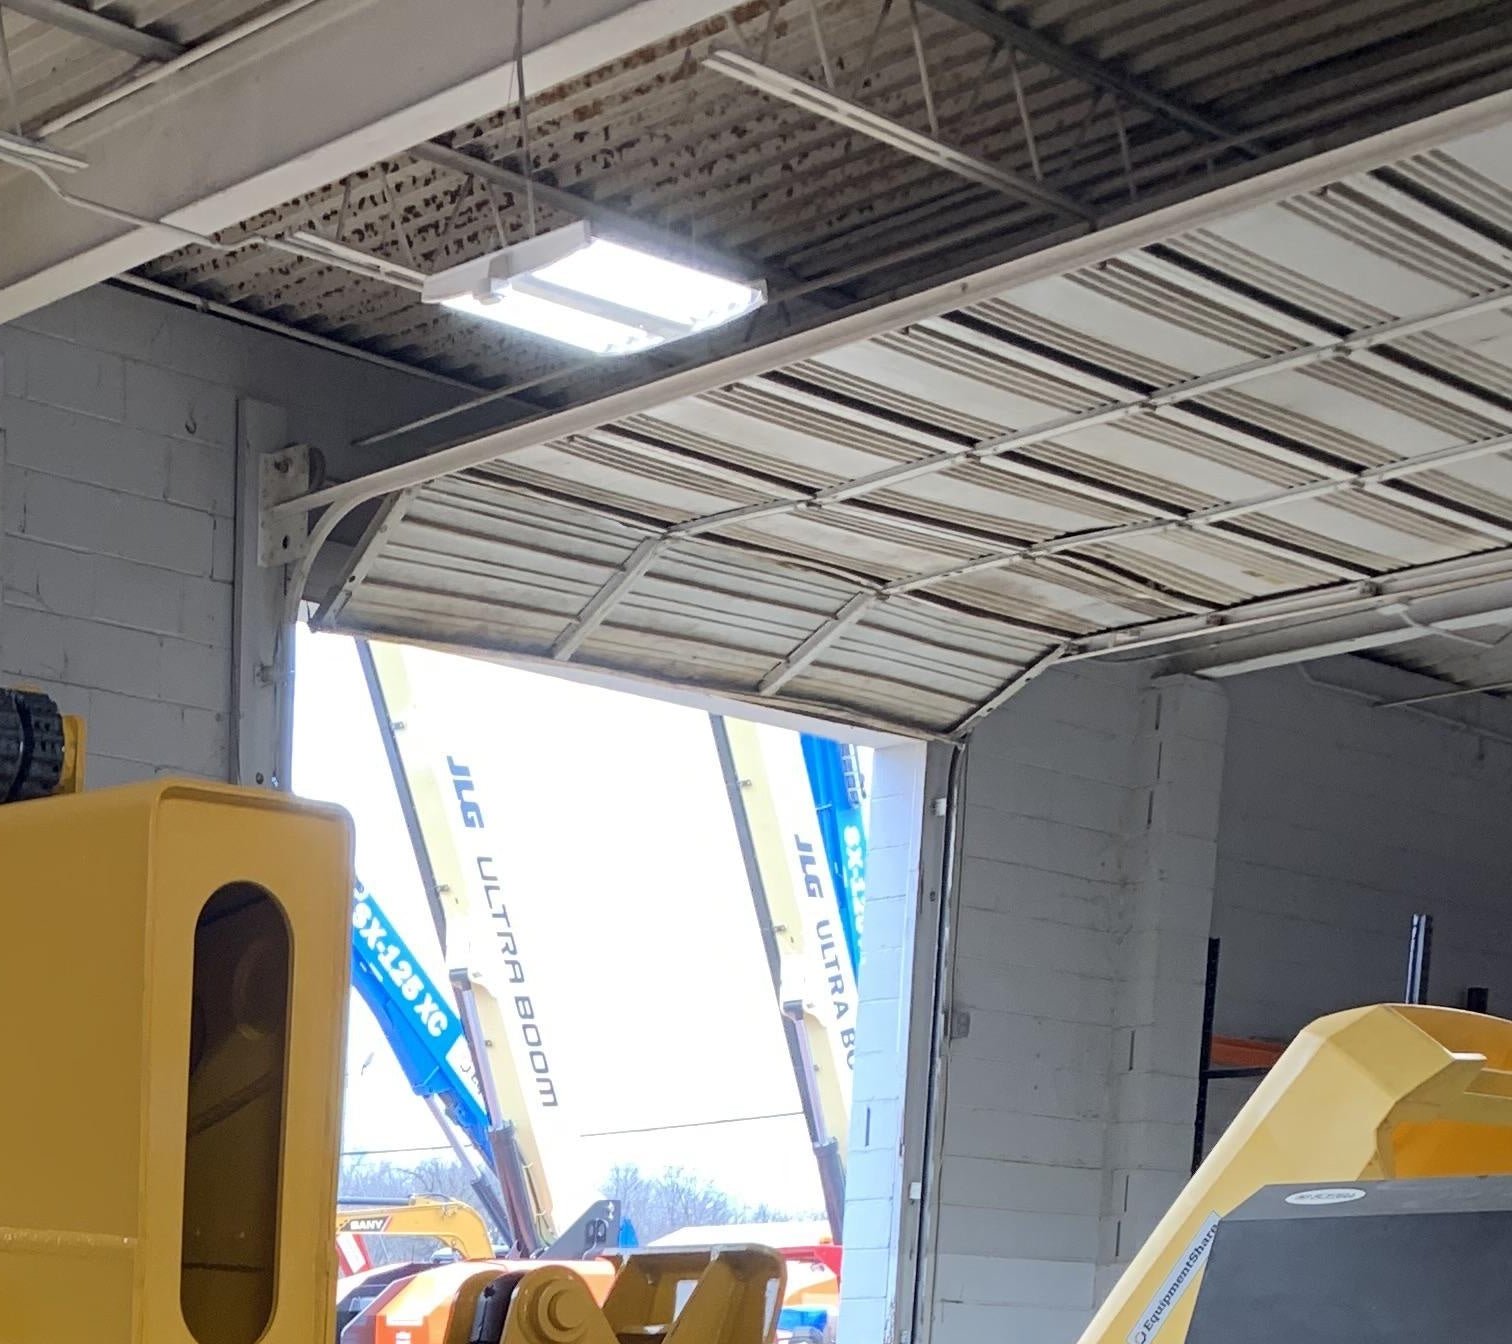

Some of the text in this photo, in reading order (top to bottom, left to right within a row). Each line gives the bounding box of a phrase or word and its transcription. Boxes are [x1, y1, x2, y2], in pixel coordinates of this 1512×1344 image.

[446, 755, 559, 1107] JLG ULTRA BOOM
[794, 833, 824, 898] JLG
[816, 919, 849, 1021] ULTRA
[413, 993, 448, 1037] XC
[350, 1219, 384, 1231] SANY
